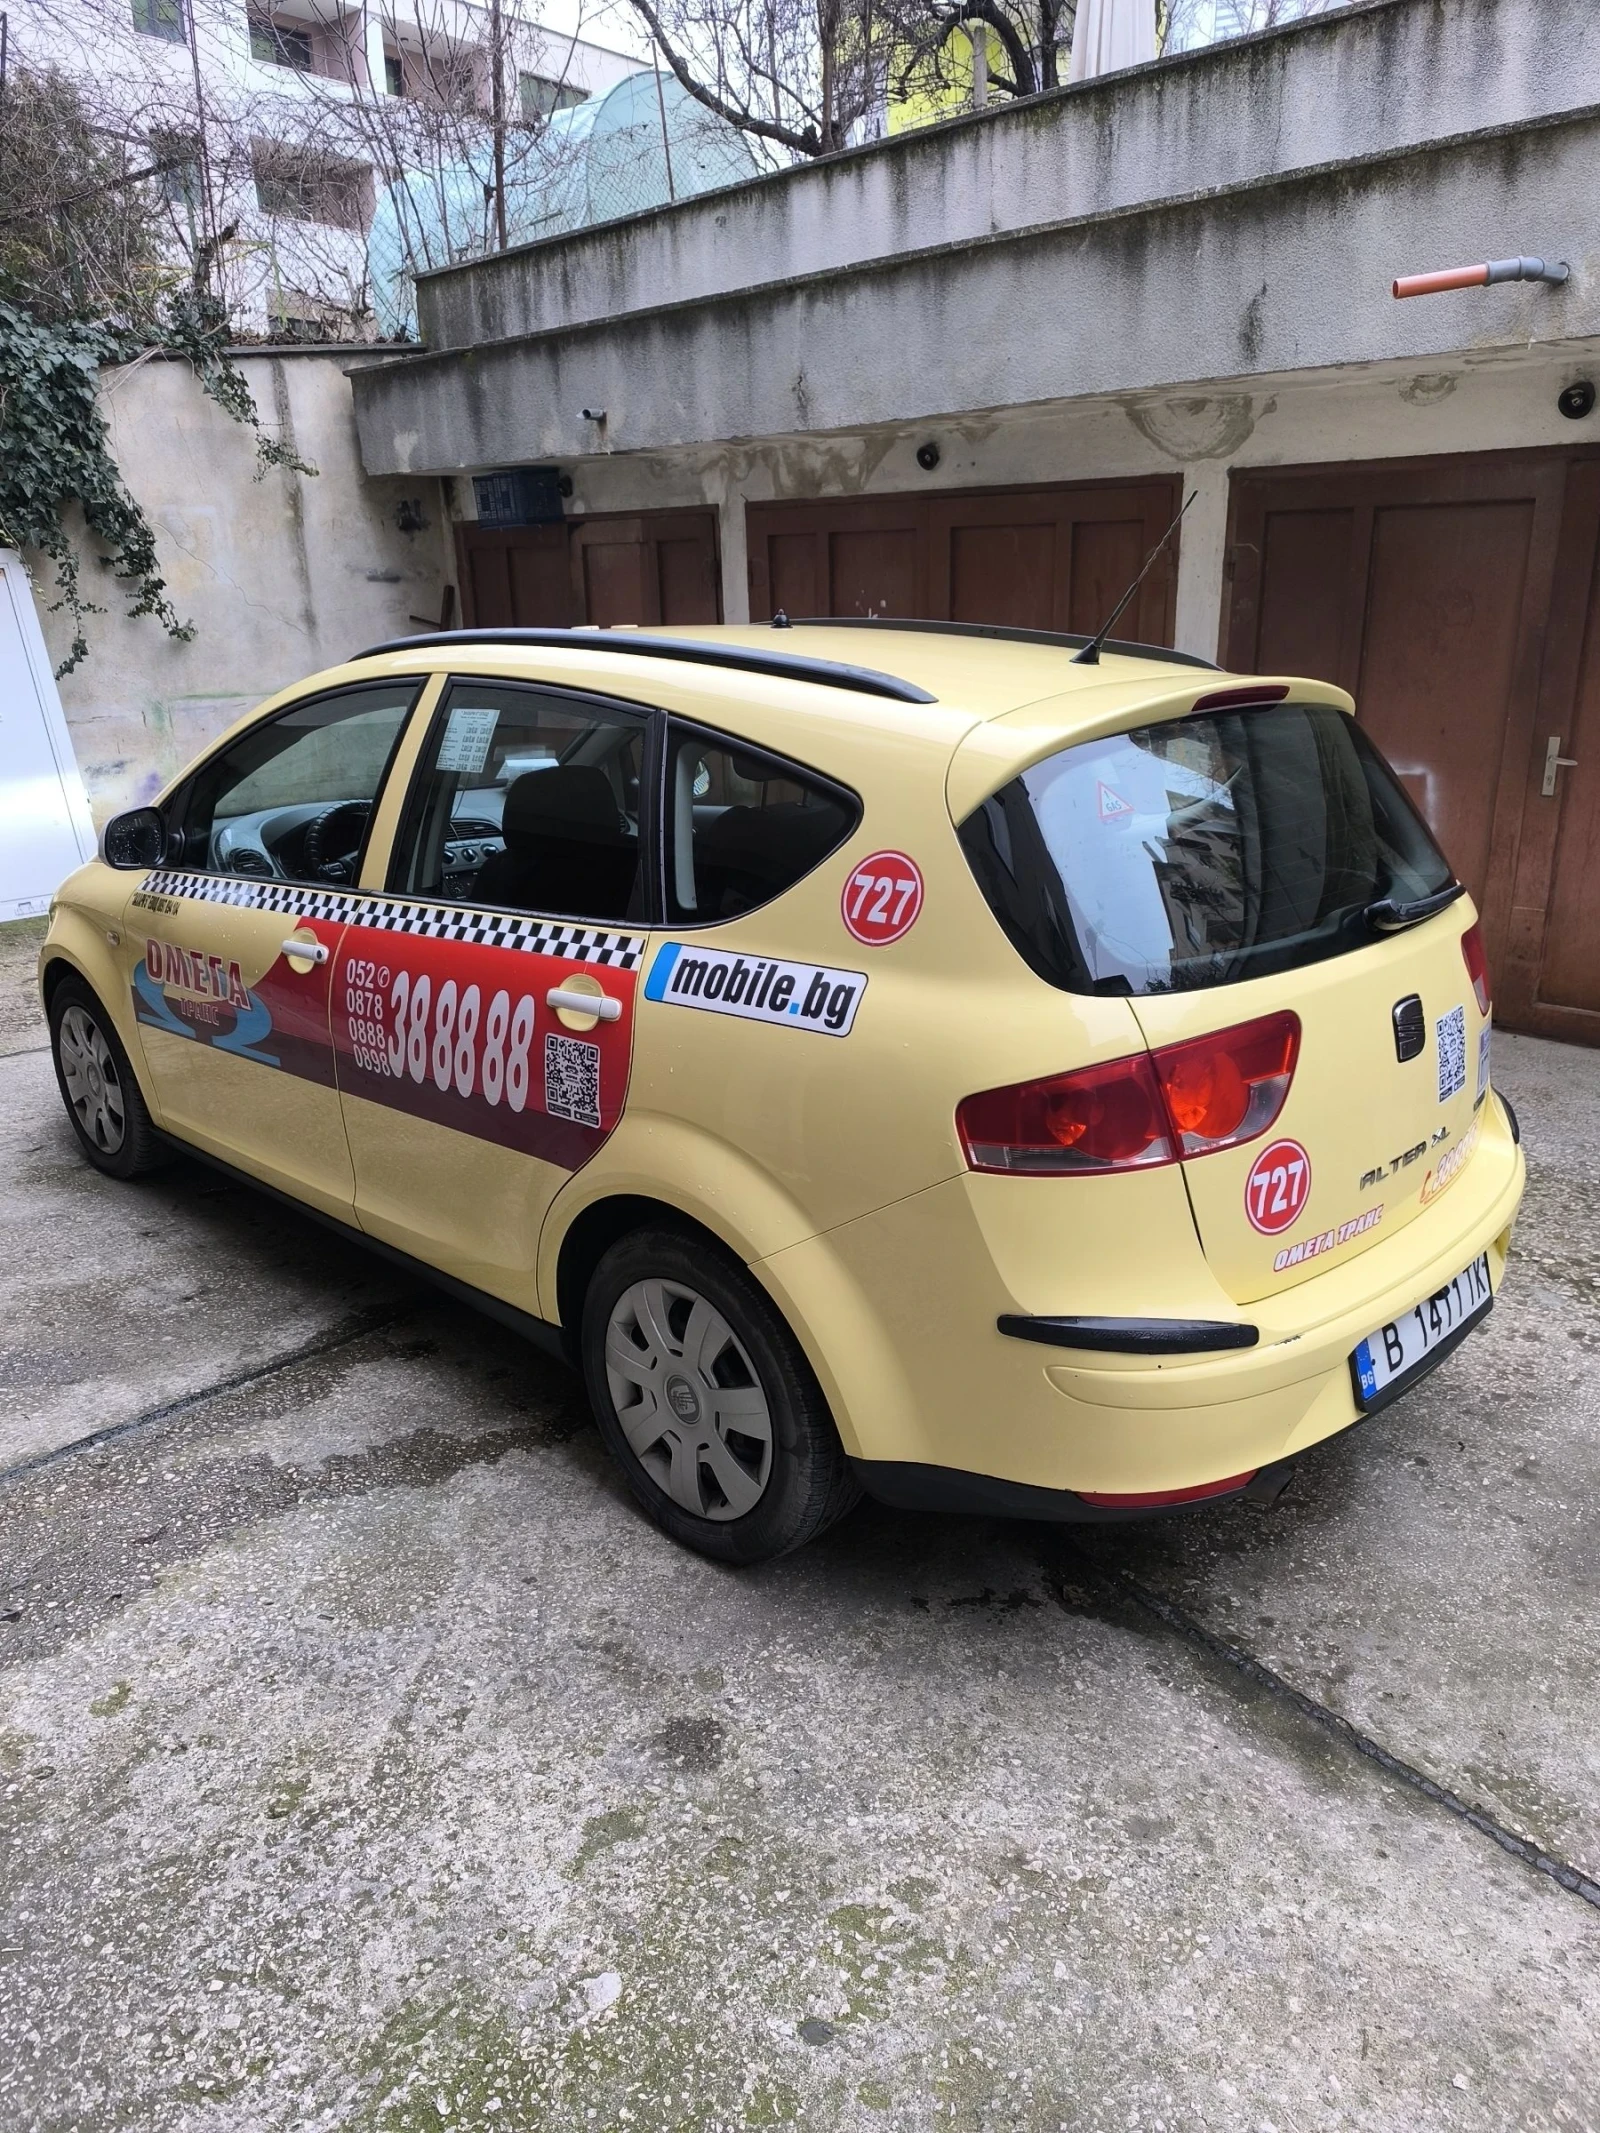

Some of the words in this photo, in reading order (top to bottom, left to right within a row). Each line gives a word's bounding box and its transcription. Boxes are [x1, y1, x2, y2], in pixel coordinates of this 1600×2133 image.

[1105, 800, 1122, 812] GAS
[850, 874, 916, 925] 727
[145, 938, 251, 1011] ОМЕГА
[346, 958, 375, 989] 052
[671, 958, 856, 1029] mobile.bg
[346, 988, 383, 1020] 0878
[348, 1016, 386, 1049] 0888
[388, 970, 535, 1113] 388888
[353, 1044, 391, 1077] 0898
[1360, 1141, 1427, 1191] ALTEA
[1431, 1126, 1451, 1148] XL
[1253, 1160, 1304, 1219] 727
[1273, 1229, 1335, 1272] ОМЕГА
[1337, 1203, 1384, 1245] ТРАНС
[1382, 1322, 1404, 1373] B
[1462, 1257, 1486, 1306] TK
[1361, 1371, 1374, 1390] BG
